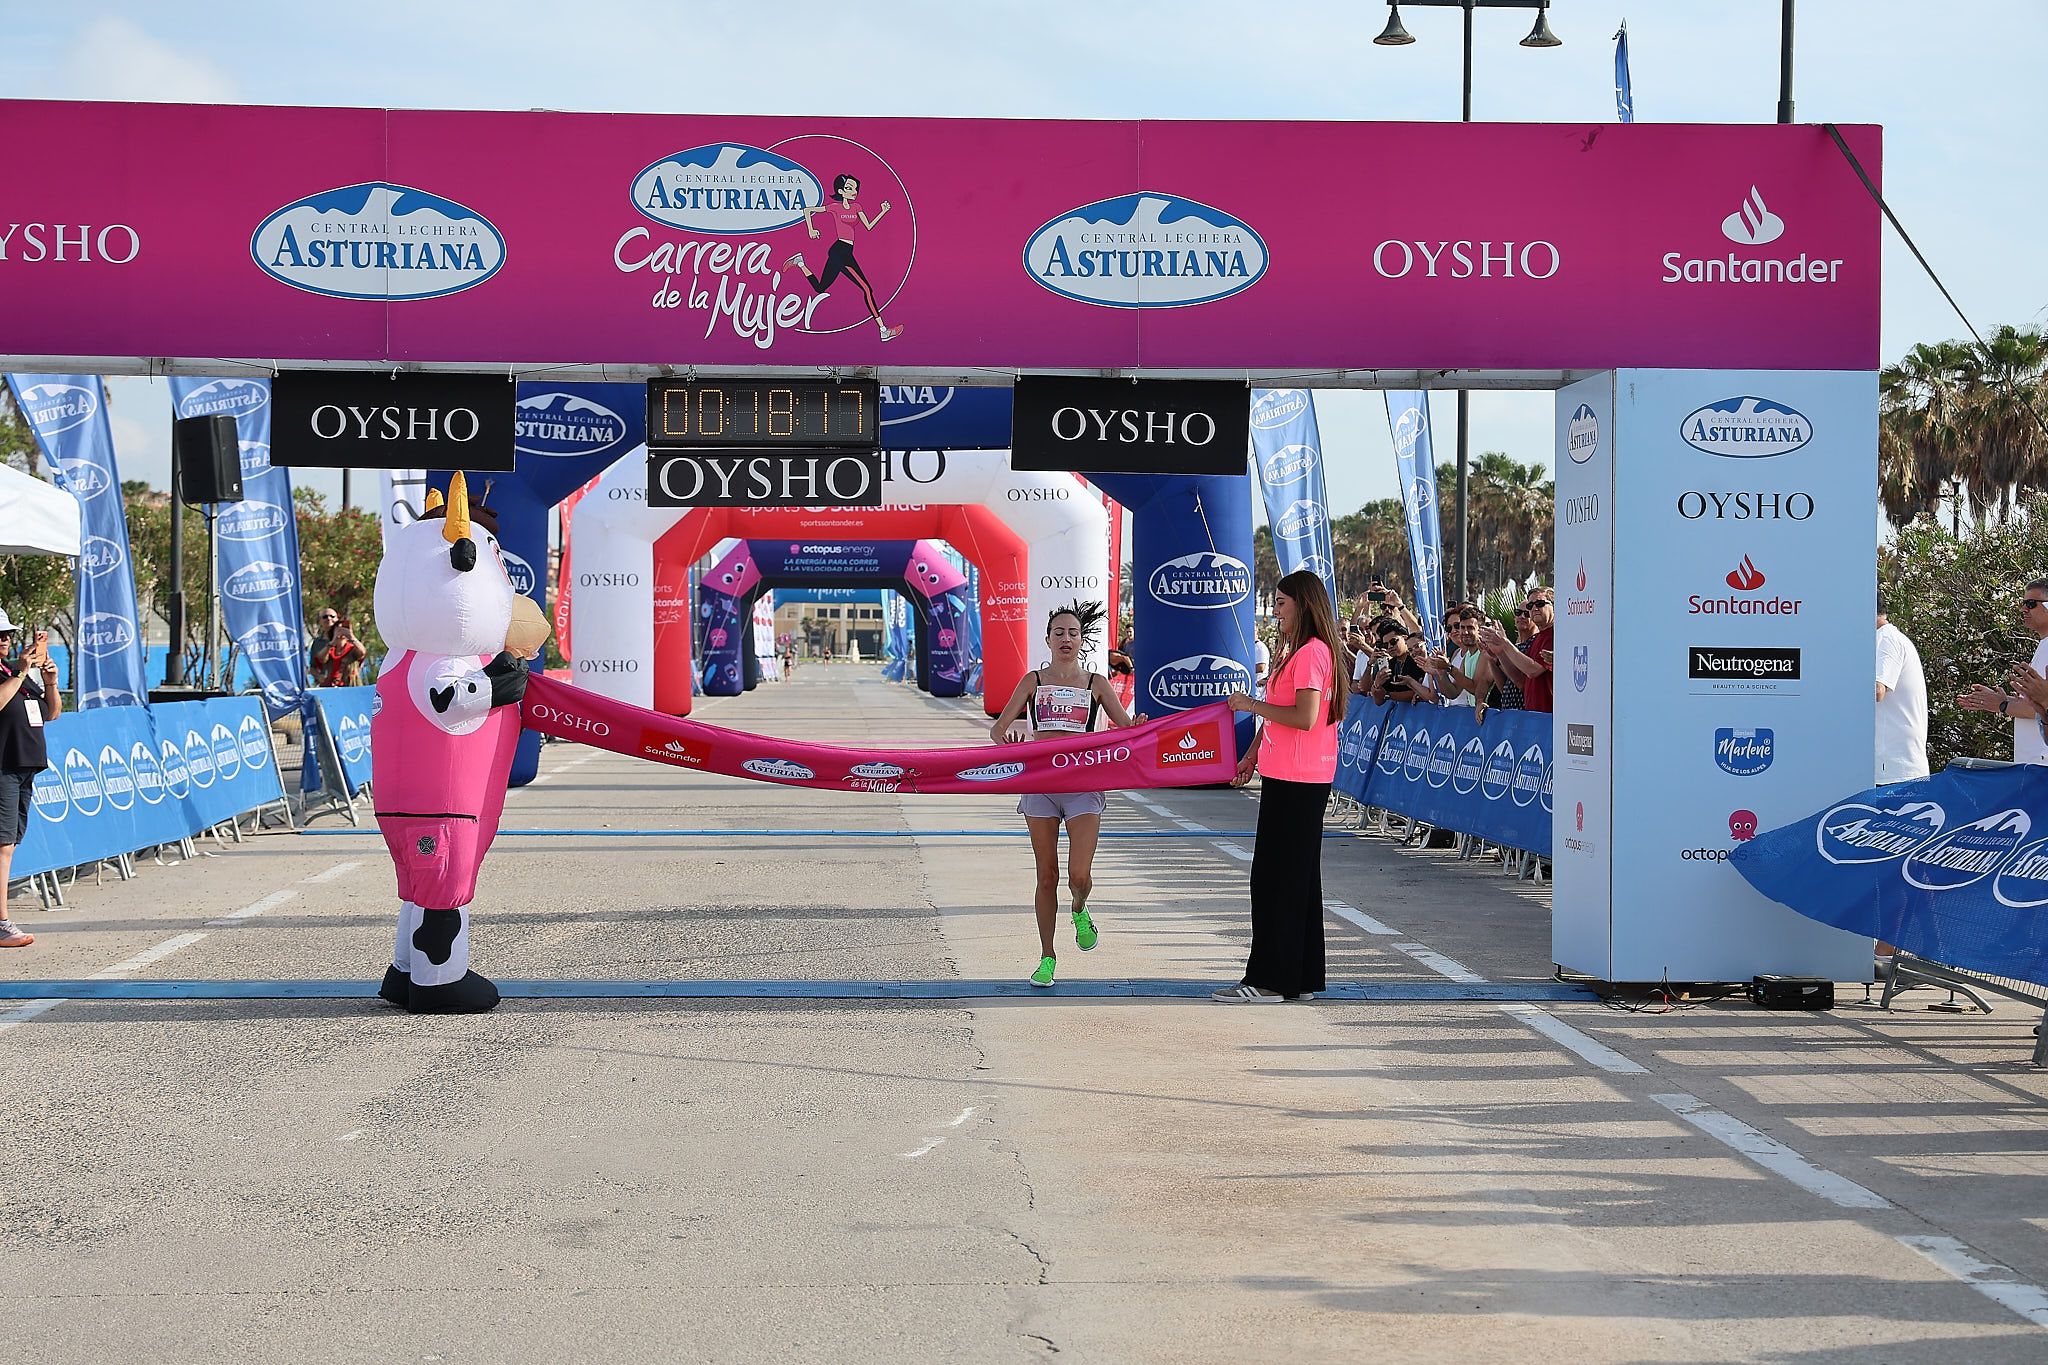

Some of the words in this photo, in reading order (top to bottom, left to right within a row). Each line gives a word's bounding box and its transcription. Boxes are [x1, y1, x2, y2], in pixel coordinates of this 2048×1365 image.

[674, 174, 736, 184] CENTRAL
[742, 174, 803, 185] LECHERA
[644, 175, 807, 211] ASTURIANA
[310, 222, 390, 235] CENTRAL
[397, 224, 480, 236] LECHERA
[1080, 232, 1157, 243] CENTRAL
[1164, 234, 1242, 244] LECHERA
[0, 222, 140, 264] YSHO
[270, 223, 487, 271] ASTURIANA
[614, 226, 772, 277] Carrera
[1043, 234, 1249, 278] ASTURIANA
[1372, 239, 1562, 280] OYSHO
[1661, 252, 1843, 283] Santander
[652, 276, 682, 310] de
[686, 275, 710, 311] la
[704, 272, 831, 350] Mujer
[311, 404, 480, 442] OYSHO
[517, 412, 563, 421] CENTRAL
[567, 415, 613, 425] LECHERA
[662, 389, 863, 436] 00:18:17
[515, 421, 614, 442] STURIANA
[1050, 407, 1217, 446] OYSHO
[1689, 418, 1804, 443] ASTURIANA
[659, 456, 870, 500] OYSHO
[608, 487, 648, 501] OYS
[1007, 487, 1069, 501] OYSHO
[1566, 494, 1598, 525] OYSHO
[1677, 491, 1815, 520] OYSHO
[799, 519, 864, 528] sportssantander.es
[795, 557, 826, 565] ENERGÍA
[803, 545, 842, 556] octopus
[842, 545, 875, 556] energy
[580, 573, 639, 587] OYSHO
[654, 585, 673, 593] orts
[998, 581, 1026, 592] Sports
[1040, 575, 1099, 589] OYSHO
[1155, 573, 1248, 595] ASTURIANA
[653, 598, 684, 607] ntander
[996, 596, 1028, 605] Santan
[1567, 596, 1595, 616] Santander
[1688, 594, 1802, 615] Santander
[579, 659, 638, 673] OYSHO
[1695, 652, 1794, 676] Neutrogena
[1154, 675, 1249, 698] ASTURIANA
[531, 704, 611, 737] OYSHO
[644, 745, 702, 764] Santander
[1051, 747, 1130, 768] OYSHO
[1162, 750, 1215, 763] Santander
[1718, 738, 1771, 764] Marlene
[747, 762, 809, 779] ASTURIANA
[853, 766, 900, 775] ASTURIANA
[1720, 761, 1731, 771] HIJA
[1751, 763, 1766, 773] ALPES
